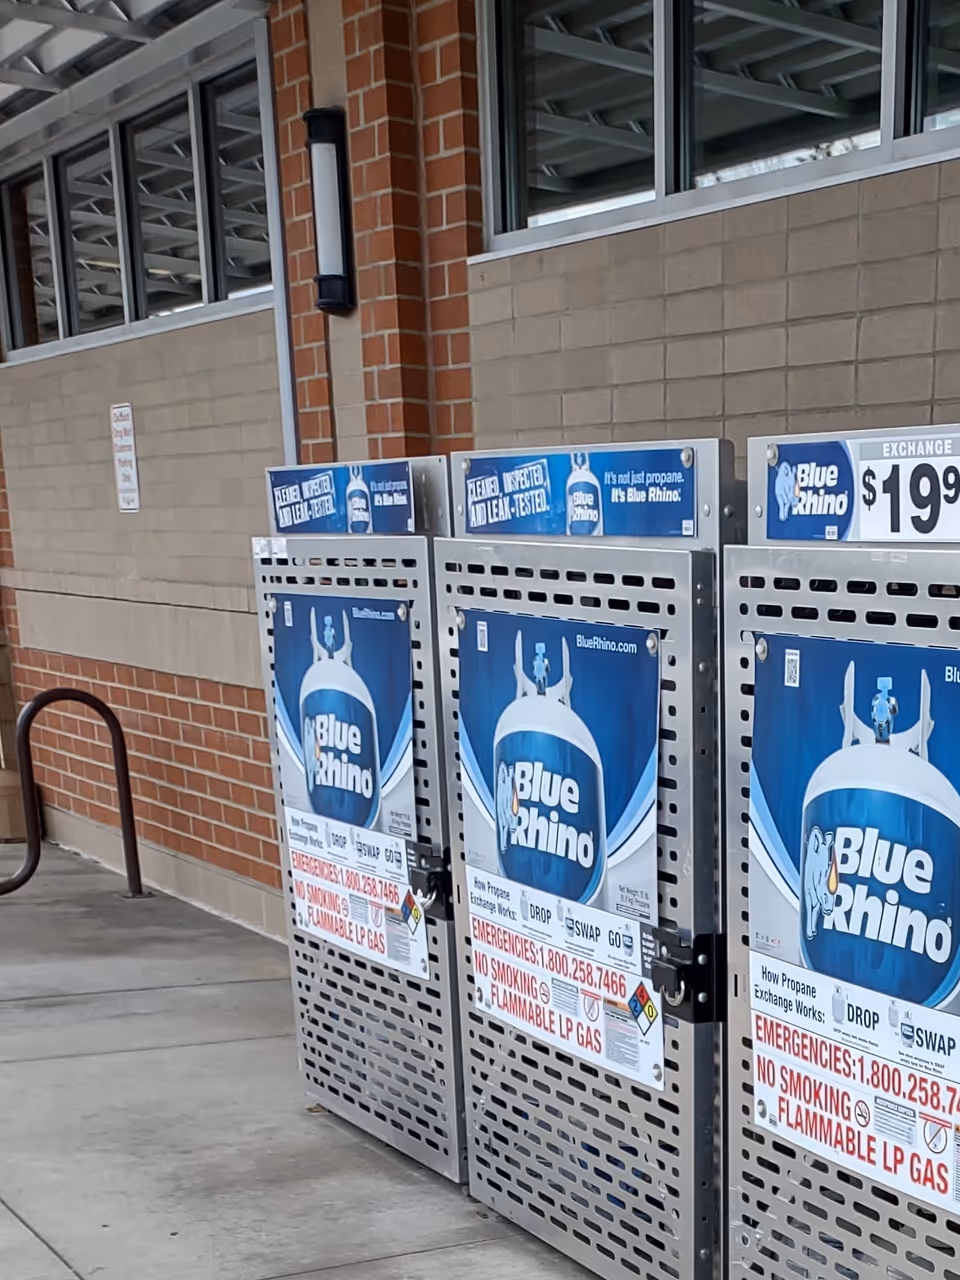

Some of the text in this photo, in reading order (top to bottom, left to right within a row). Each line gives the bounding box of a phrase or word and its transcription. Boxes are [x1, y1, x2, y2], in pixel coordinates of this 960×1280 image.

[883, 440, 953, 457] EXCHANGE
[604, 472, 684, 487] It's not just propane.
[796, 463, 838, 488] Blue
[573, 491, 594, 505] Blue
[611, 488, 625, 503] It's
[627, 487, 646, 503] Blue
[792, 490, 848, 516] Rhino
[470, 502, 487, 527] AND
[576, 634, 638, 654] BlueRhino.com
[315, 713, 361, 755] Blue
[315, 751, 373, 799] Rhino
[514, 761, 580, 814] Blue
[363, 842, 380, 860] SWAP
[511, 807, 594, 869] Rhino
[834, 827, 934, 894] Blue
[295, 880, 306, 900] NO
[307, 884, 341, 917] SMOKING
[474, 877, 510, 901] How Propane
[470, 889, 517, 921] Exchange Works:
[530, 904, 552, 925] DROP
[308, 906, 353, 942] FLAMMABLE
[356, 924, 365, 946] LP
[367, 929, 386, 954] GAS
[575, 920, 601, 943] SWAP
[823, 884, 952, 963] Rhino
[608, 930, 621, 949] GO
[474, 950, 489, 976] NO
[491, 957, 538, 999] SMOKING
[761, 965, 817, 999] How Propane
[490, 982, 556, 1035] FLAMMABLE
[559, 1014, 573, 1041] LP
[577, 1021, 602, 1055] GAS
[648, 1005, 653, 1018] 0
[754, 984, 825, 1024] Exchange Works:
[847, 1003, 880, 1031] DROP
[915, 1027, 956, 1057] SWAP
[756, 1054, 776, 1088] NO
[780, 1061, 851, 1121] SMOKING
[778, 1096, 877, 1166] FLAMMABLE
[883, 1139, 904, 1175] LP
[909, 1152, 949, 1195] GAS
